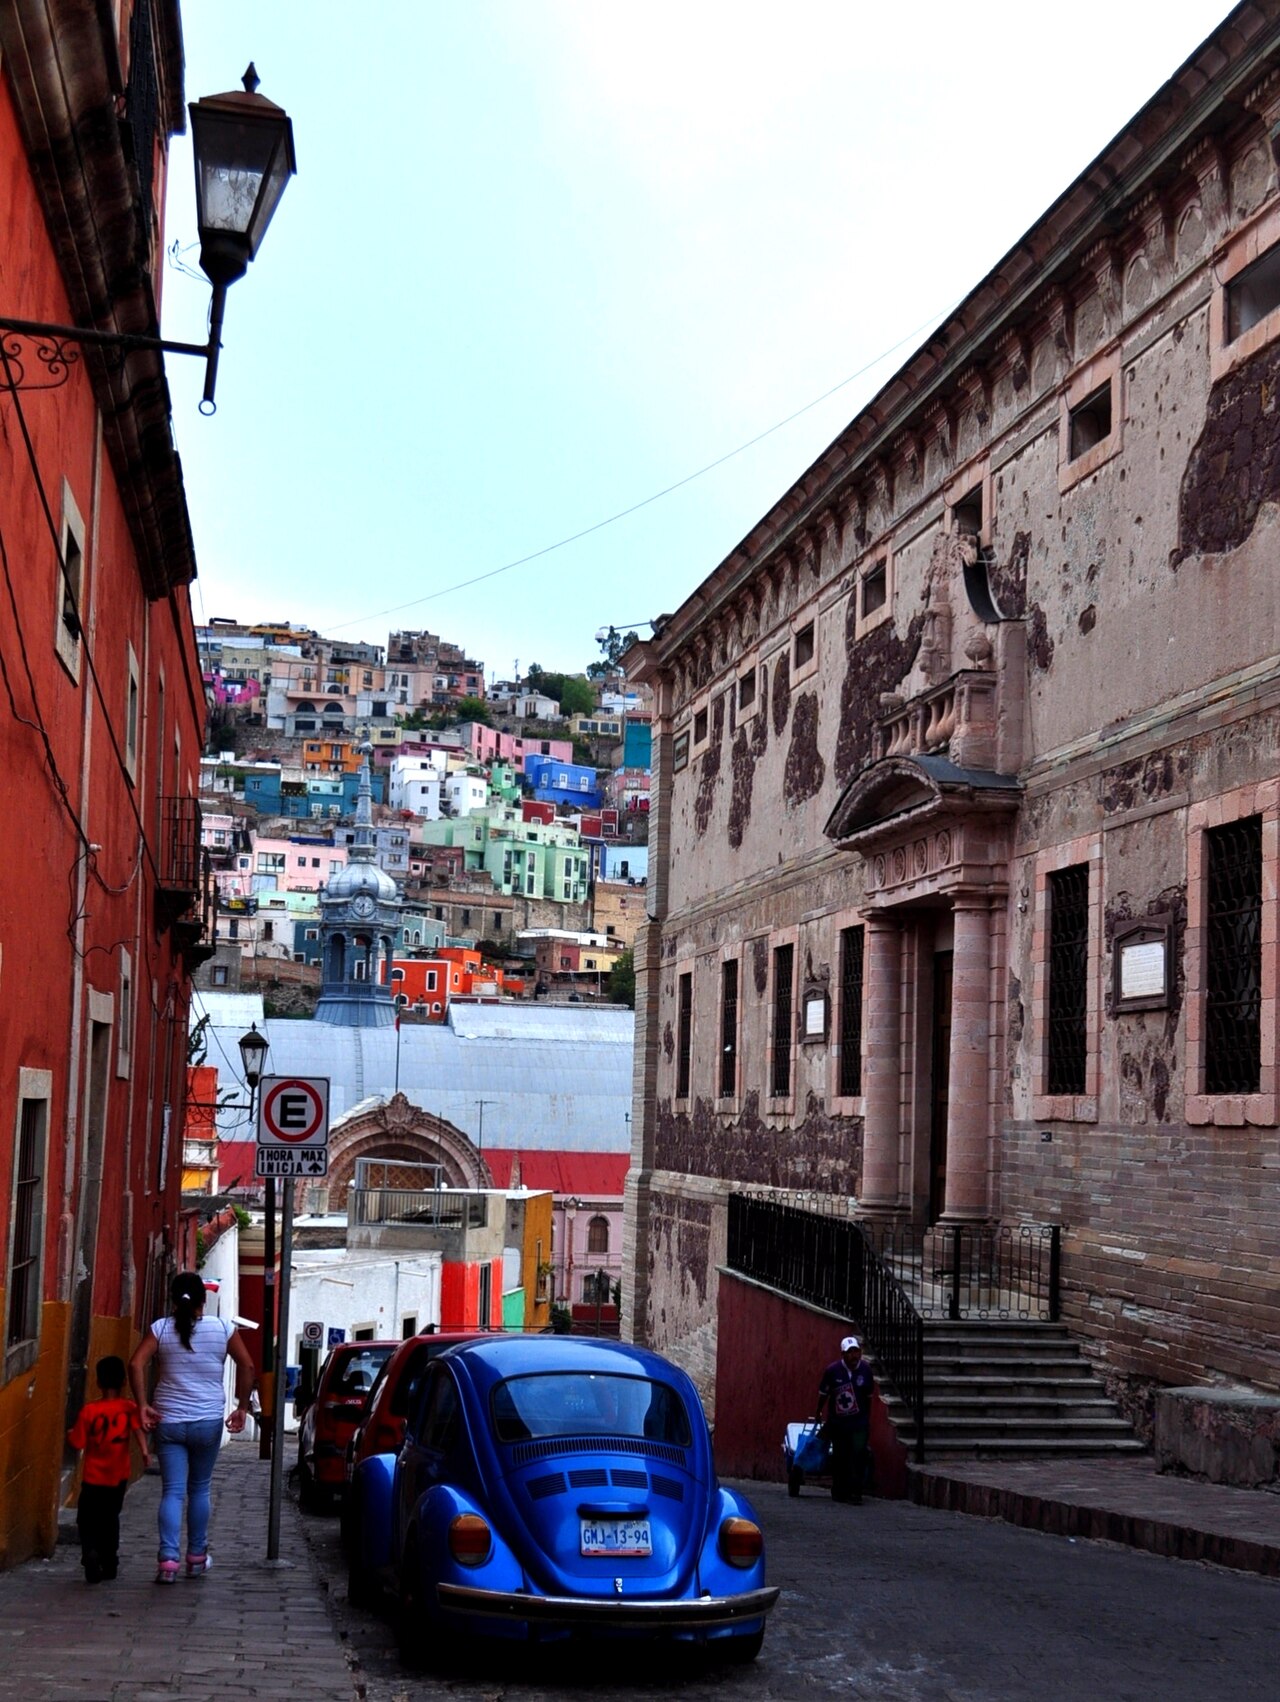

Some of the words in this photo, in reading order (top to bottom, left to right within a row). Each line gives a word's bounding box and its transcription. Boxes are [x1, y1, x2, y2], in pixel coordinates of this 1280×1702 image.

[279, 1095, 307, 1128] E
[301, 1150, 324, 1162] MAX
[309, 1327, 318, 1336] E
[583, 1528, 649, 1545] GMJ-13-94
